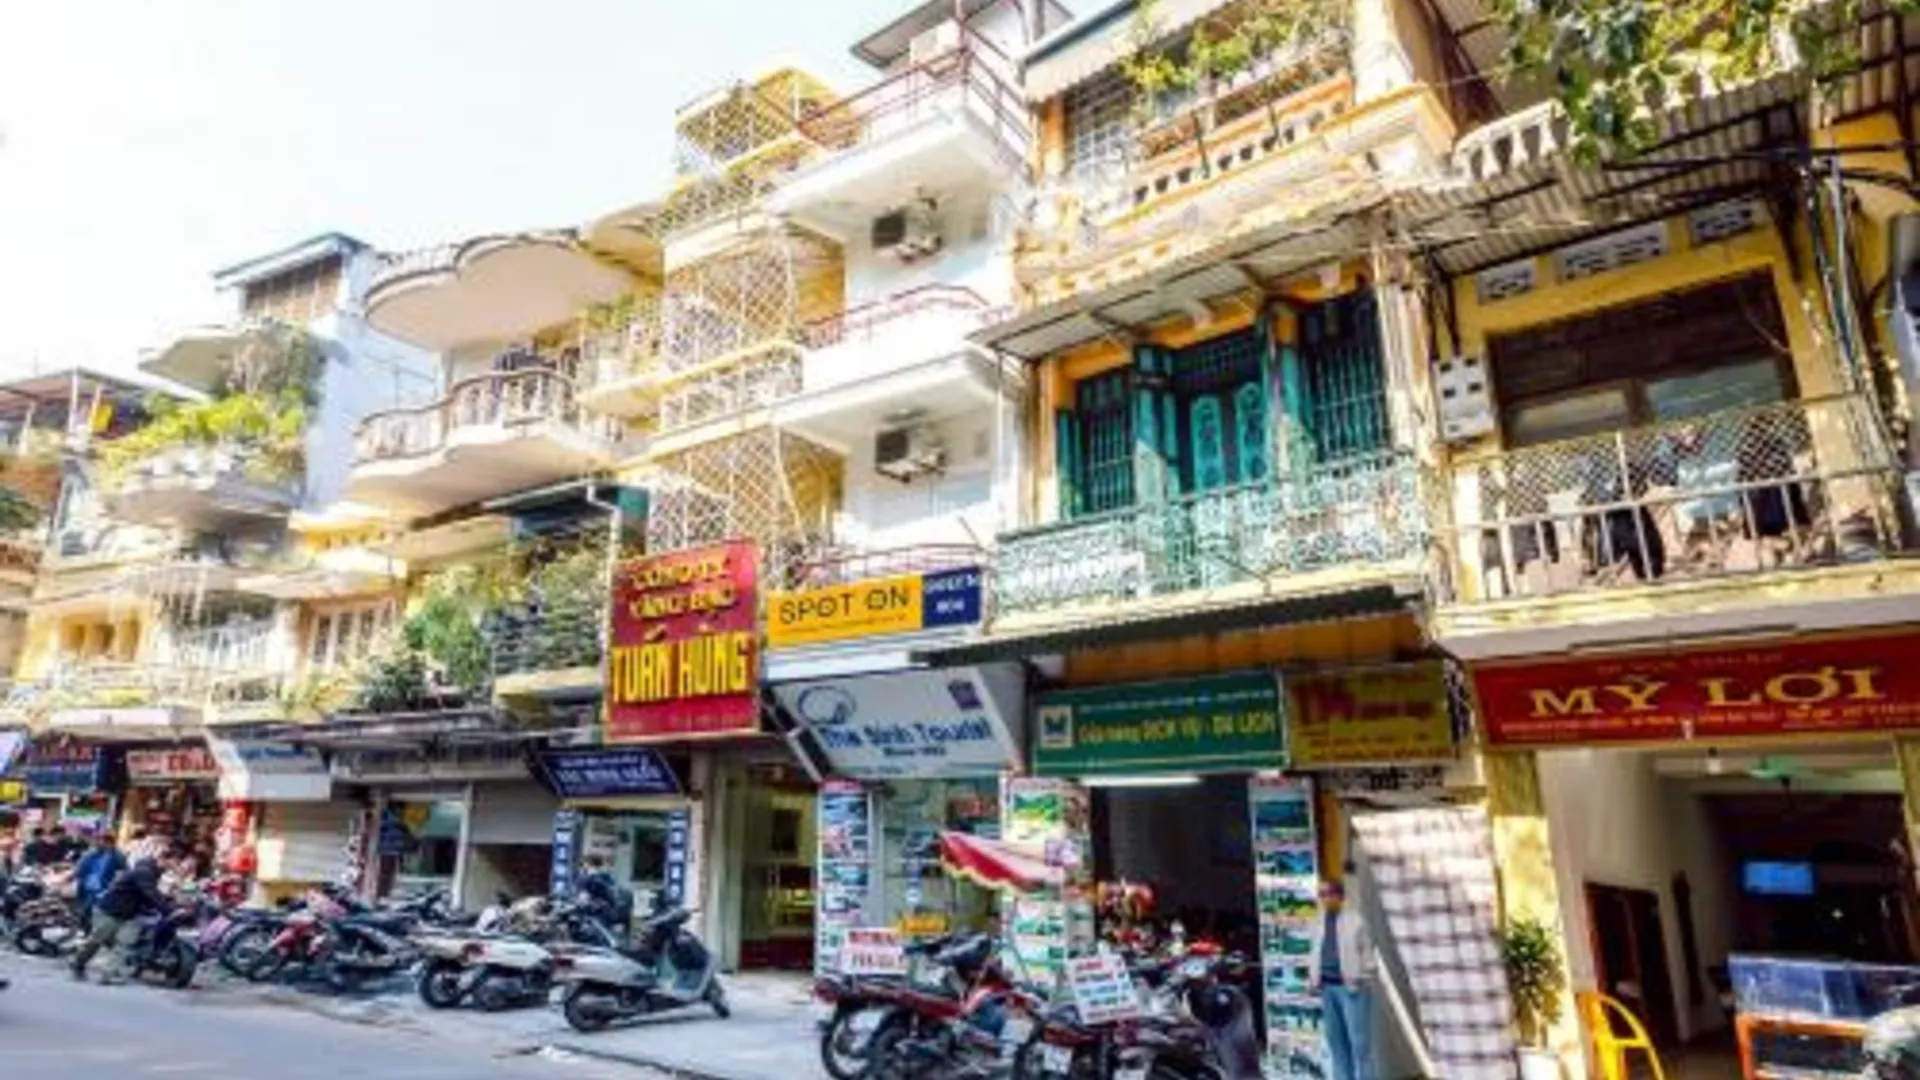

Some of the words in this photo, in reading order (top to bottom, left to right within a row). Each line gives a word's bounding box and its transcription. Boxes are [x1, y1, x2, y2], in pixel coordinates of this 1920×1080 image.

[779, 592, 854, 625] SPOT
[866, 585, 910, 611] ON
[611, 623, 672, 704] TUẤN
[1697, 665, 1887, 711] LỢI
[818, 726, 863, 748] The
